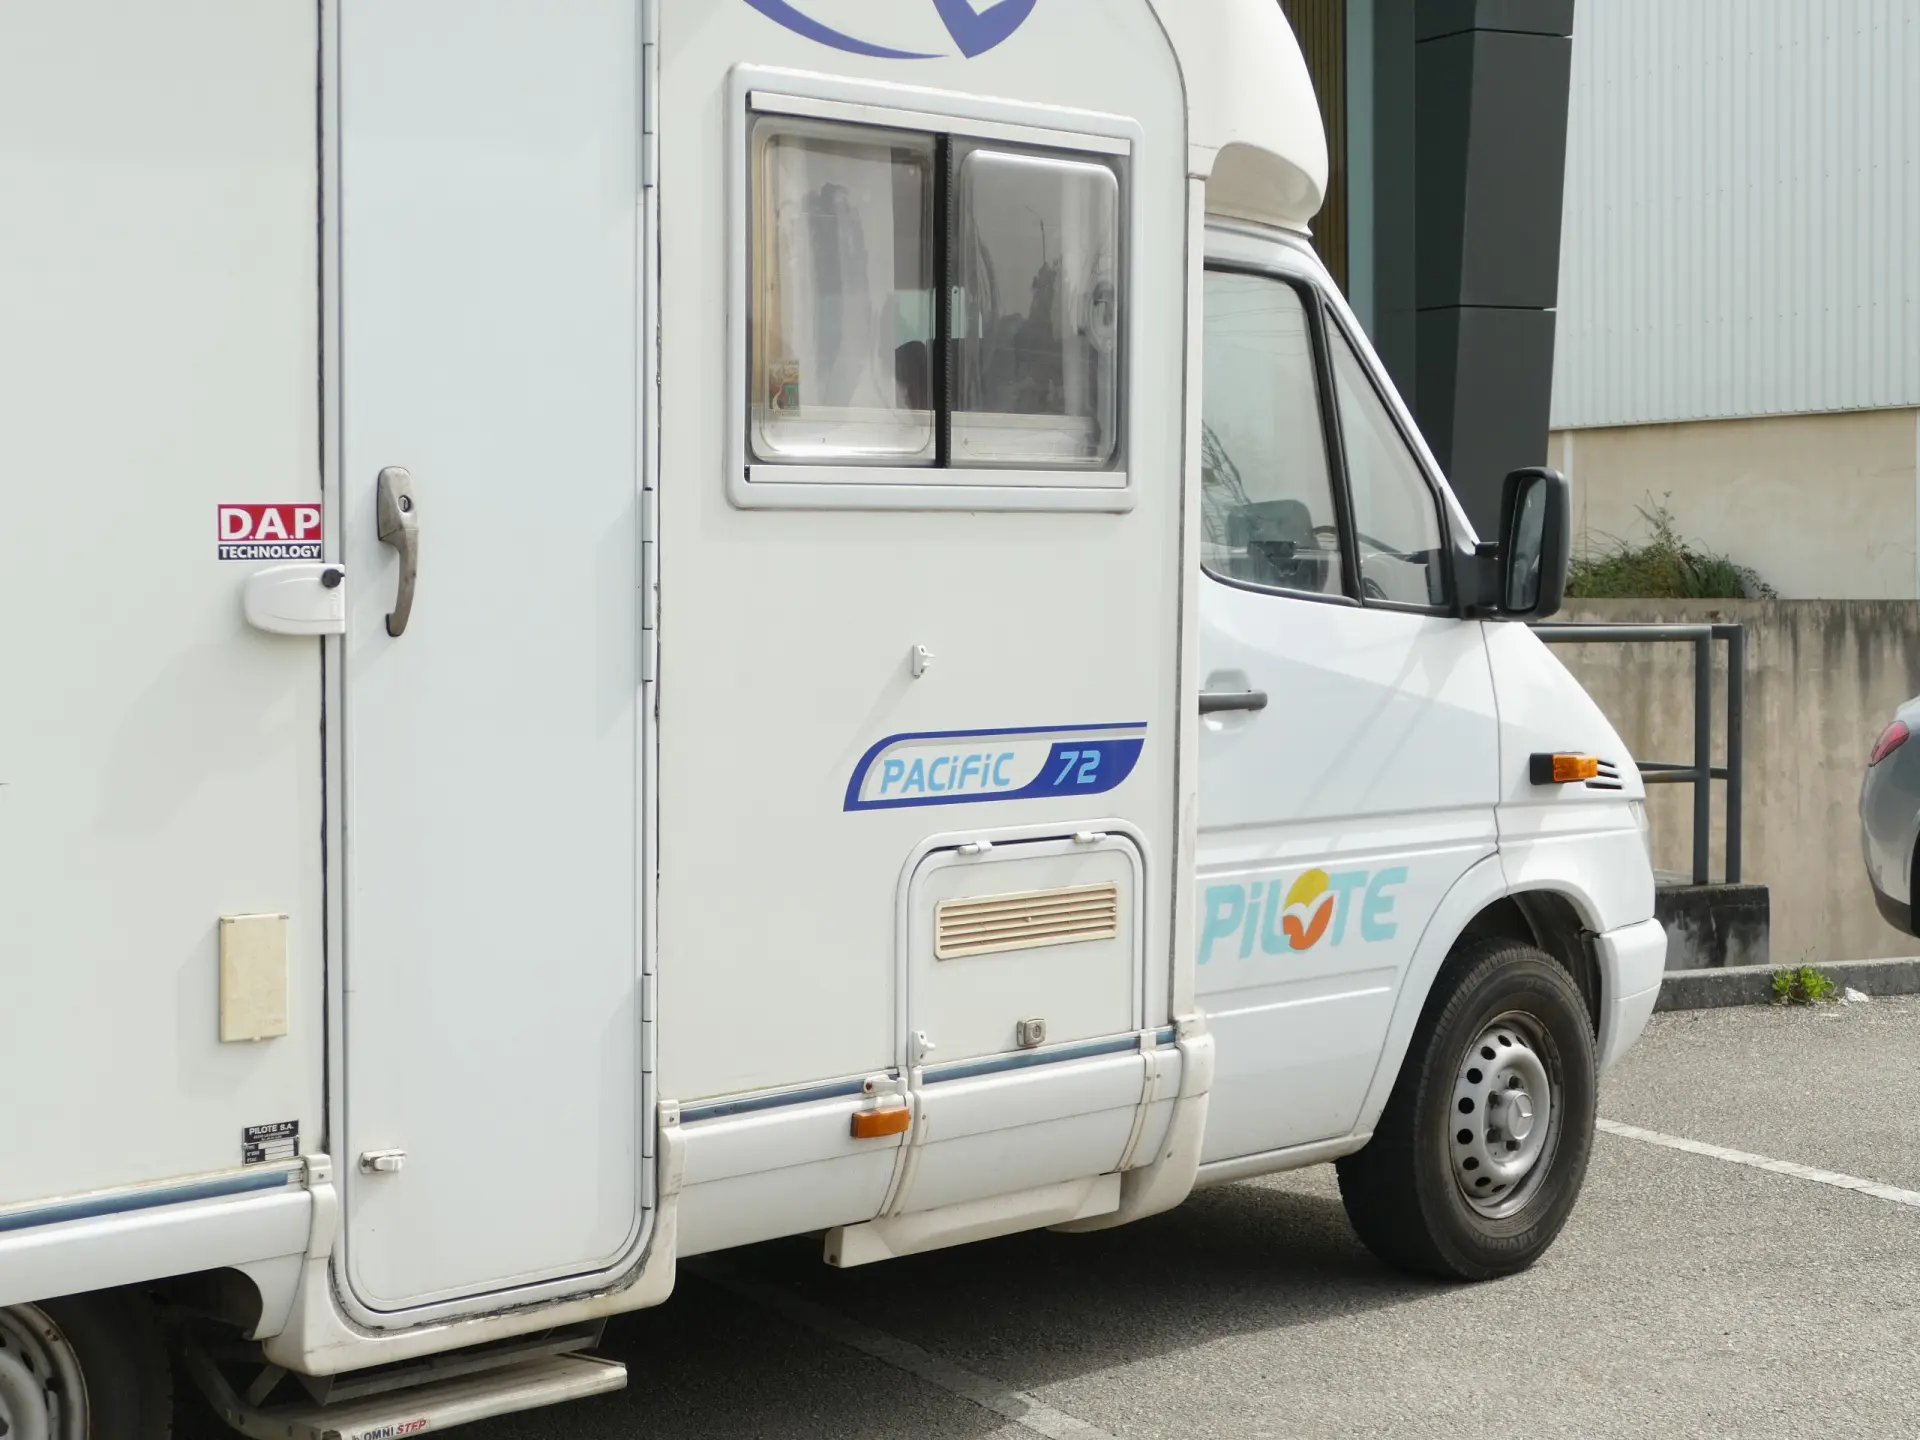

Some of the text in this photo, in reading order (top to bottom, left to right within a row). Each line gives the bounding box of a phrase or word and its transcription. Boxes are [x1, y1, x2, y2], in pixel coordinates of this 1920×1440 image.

[220, 545, 320, 558] TECHNOLOGY
[1053, 750, 1101, 786] 72
[249, 1124, 277, 1136] PILOTE
[363, 1419, 427, 1440] OMNI STEP
